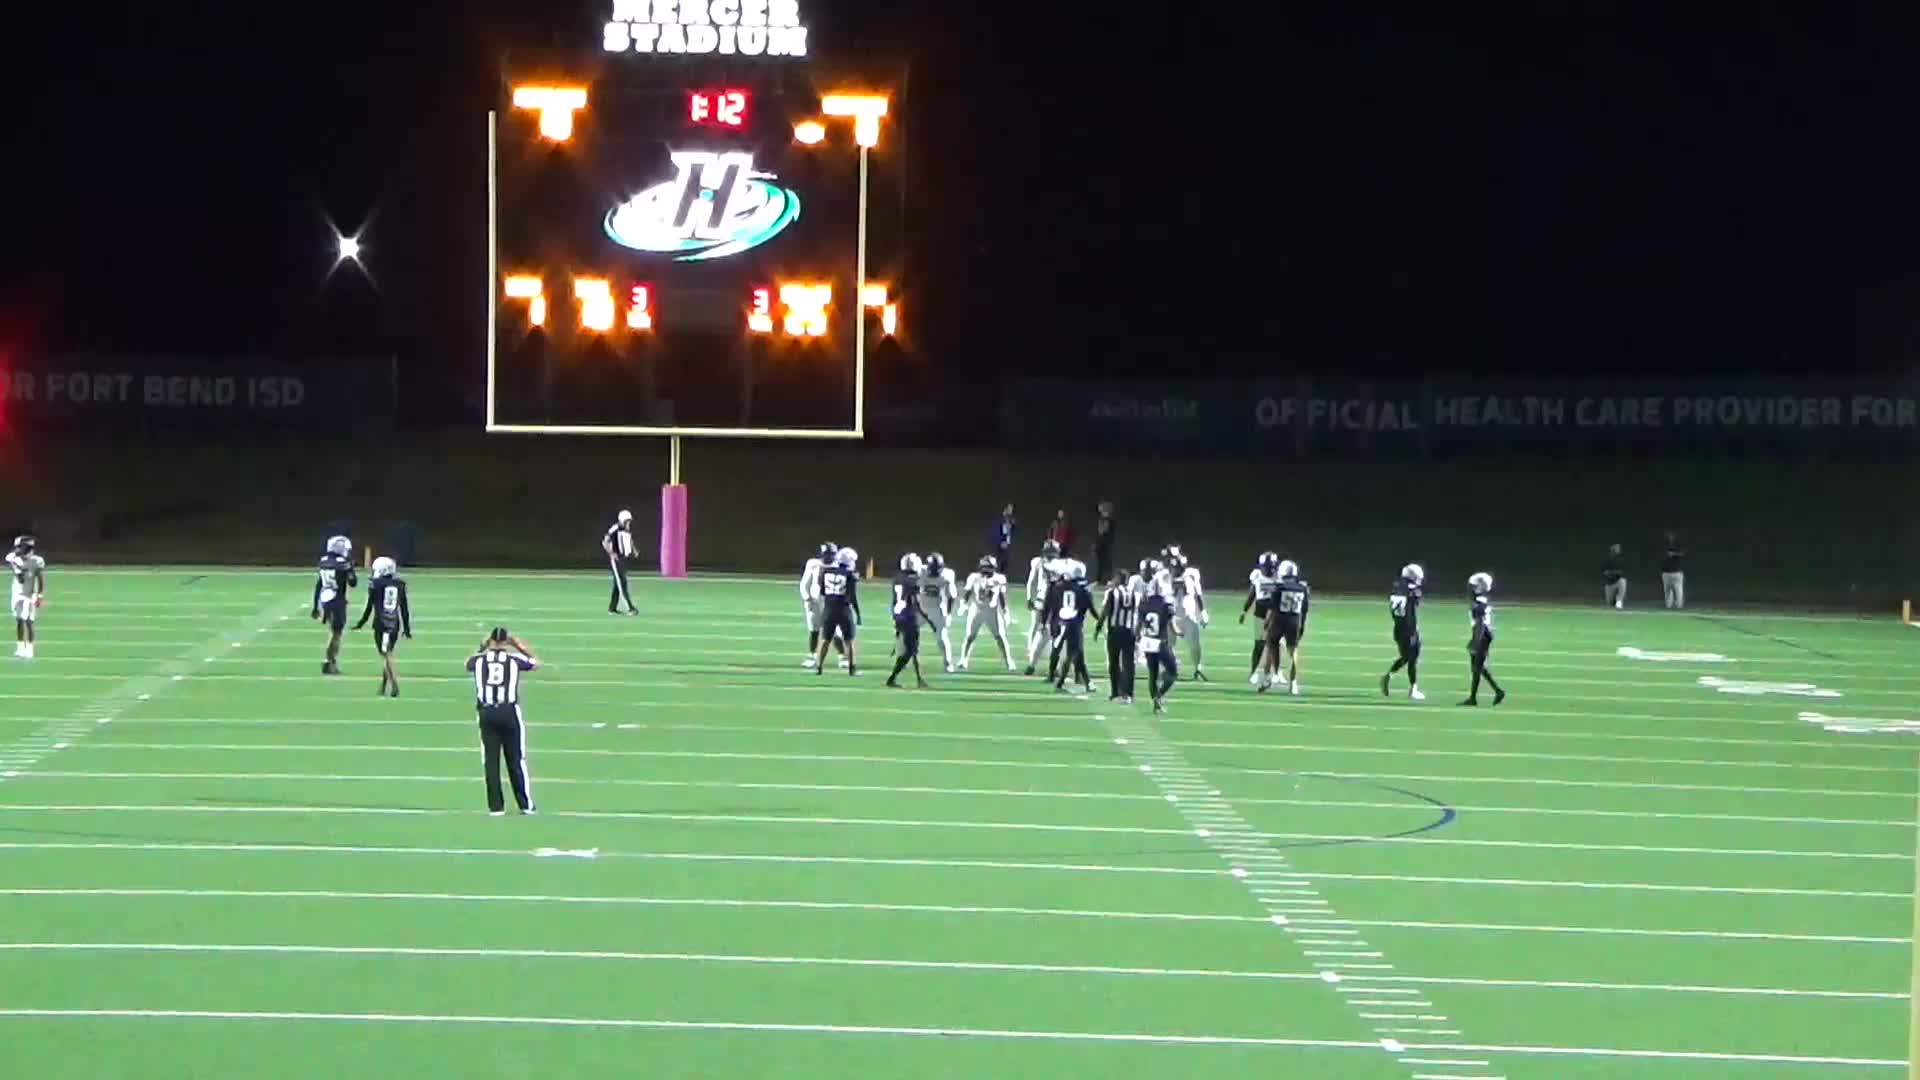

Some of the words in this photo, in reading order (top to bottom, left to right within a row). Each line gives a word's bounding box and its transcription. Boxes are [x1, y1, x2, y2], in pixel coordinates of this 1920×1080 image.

[612, 0, 800, 26] MERCER
[603, 22, 808, 56] STADIUM
[46, 371, 134, 402] FORT
[143, 375, 236, 407] BEND
[248, 377, 304, 407] ISD
[1434, 395, 1564, 426] HEALTH
[1576, 396, 1664, 427] CARE
[1673, 396, 1841, 428] PROVIDER
[1851, 397, 1918, 427] FOR
[1145, 612, 1159, 636] 3
[487, 662, 504, 686] B
